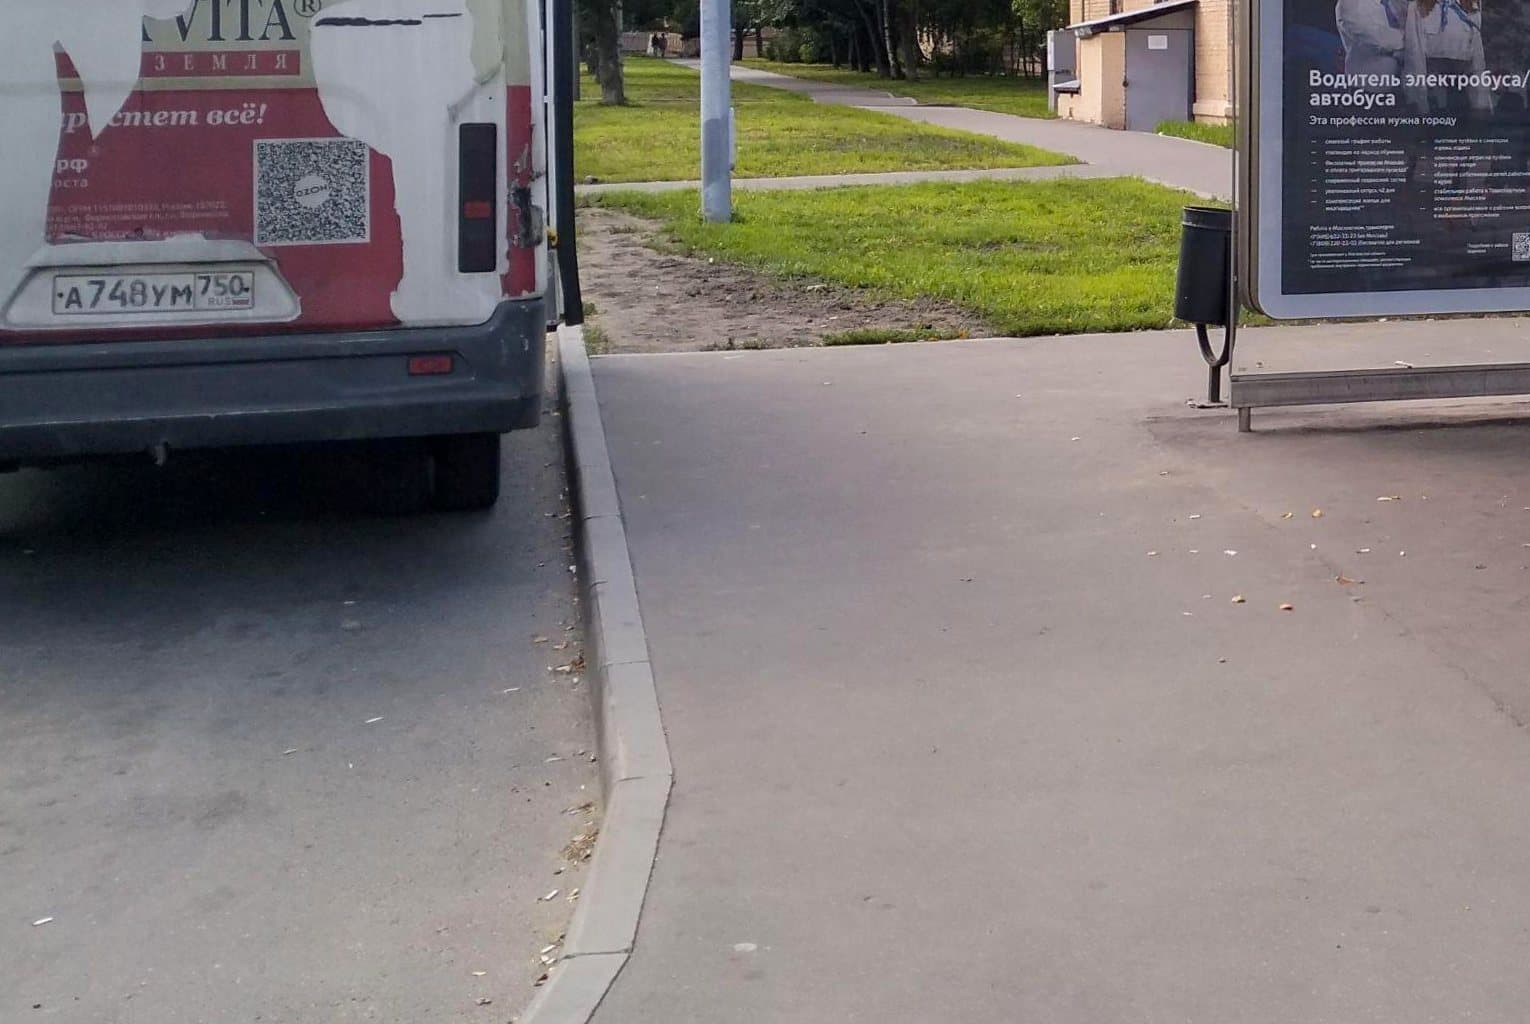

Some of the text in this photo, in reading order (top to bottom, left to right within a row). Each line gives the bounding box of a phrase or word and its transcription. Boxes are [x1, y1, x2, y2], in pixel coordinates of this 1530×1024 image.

[1309, 69, 1530, 91] Водитель электробуса/
[1309, 89, 1396, 110] автобуса
[206, 102, 268, 127] всё!
[1309, 115, 1457, 127] Эта профессия нужна городу
[51, 178, 89, 189] оста
[198, 275, 244, 296] 750
[208, 296, 232, 306] RUS
